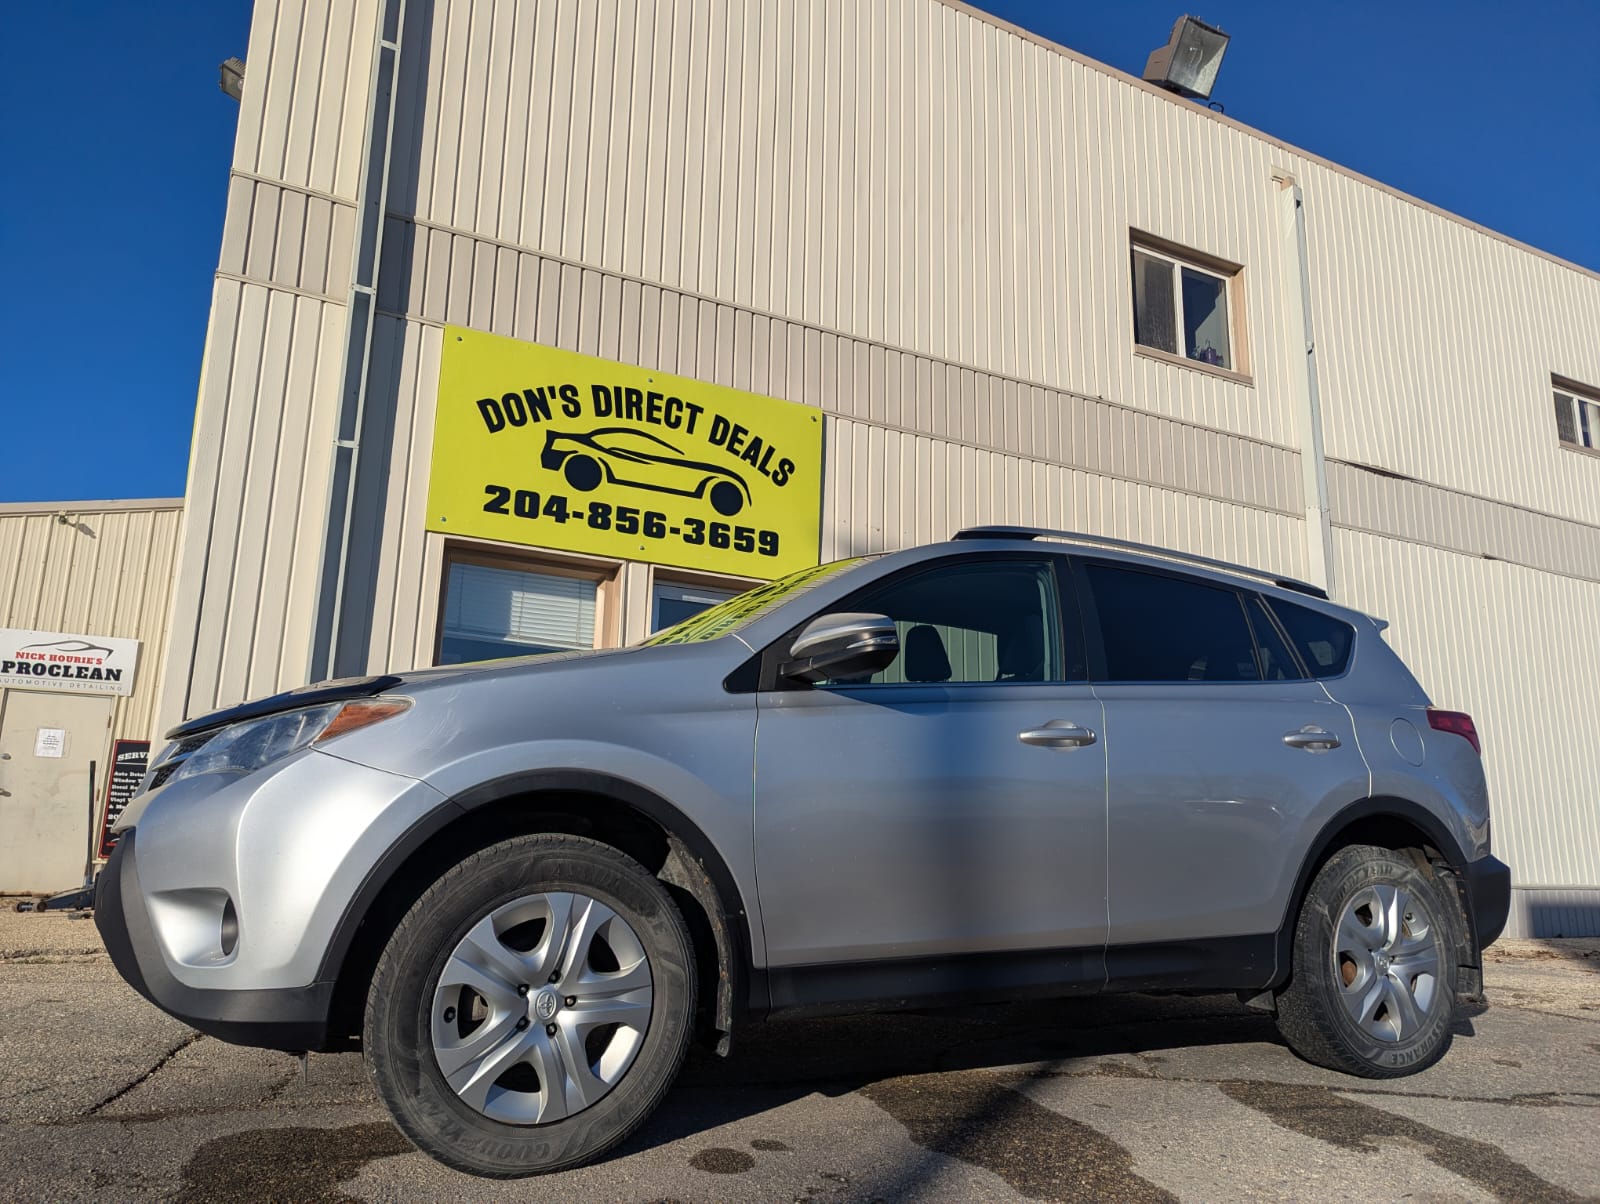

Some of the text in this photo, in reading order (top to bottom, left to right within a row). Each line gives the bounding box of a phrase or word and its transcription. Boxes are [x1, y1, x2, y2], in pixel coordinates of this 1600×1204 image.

[476, 383, 796, 488] DON'S DIRECT DEALS
[482, 484, 780, 558] 204-856-3659
[15, 651, 46, 661] NICK
[1, 660, 122, 682] PROCLEAN
[117, 752, 149, 761] SERV
